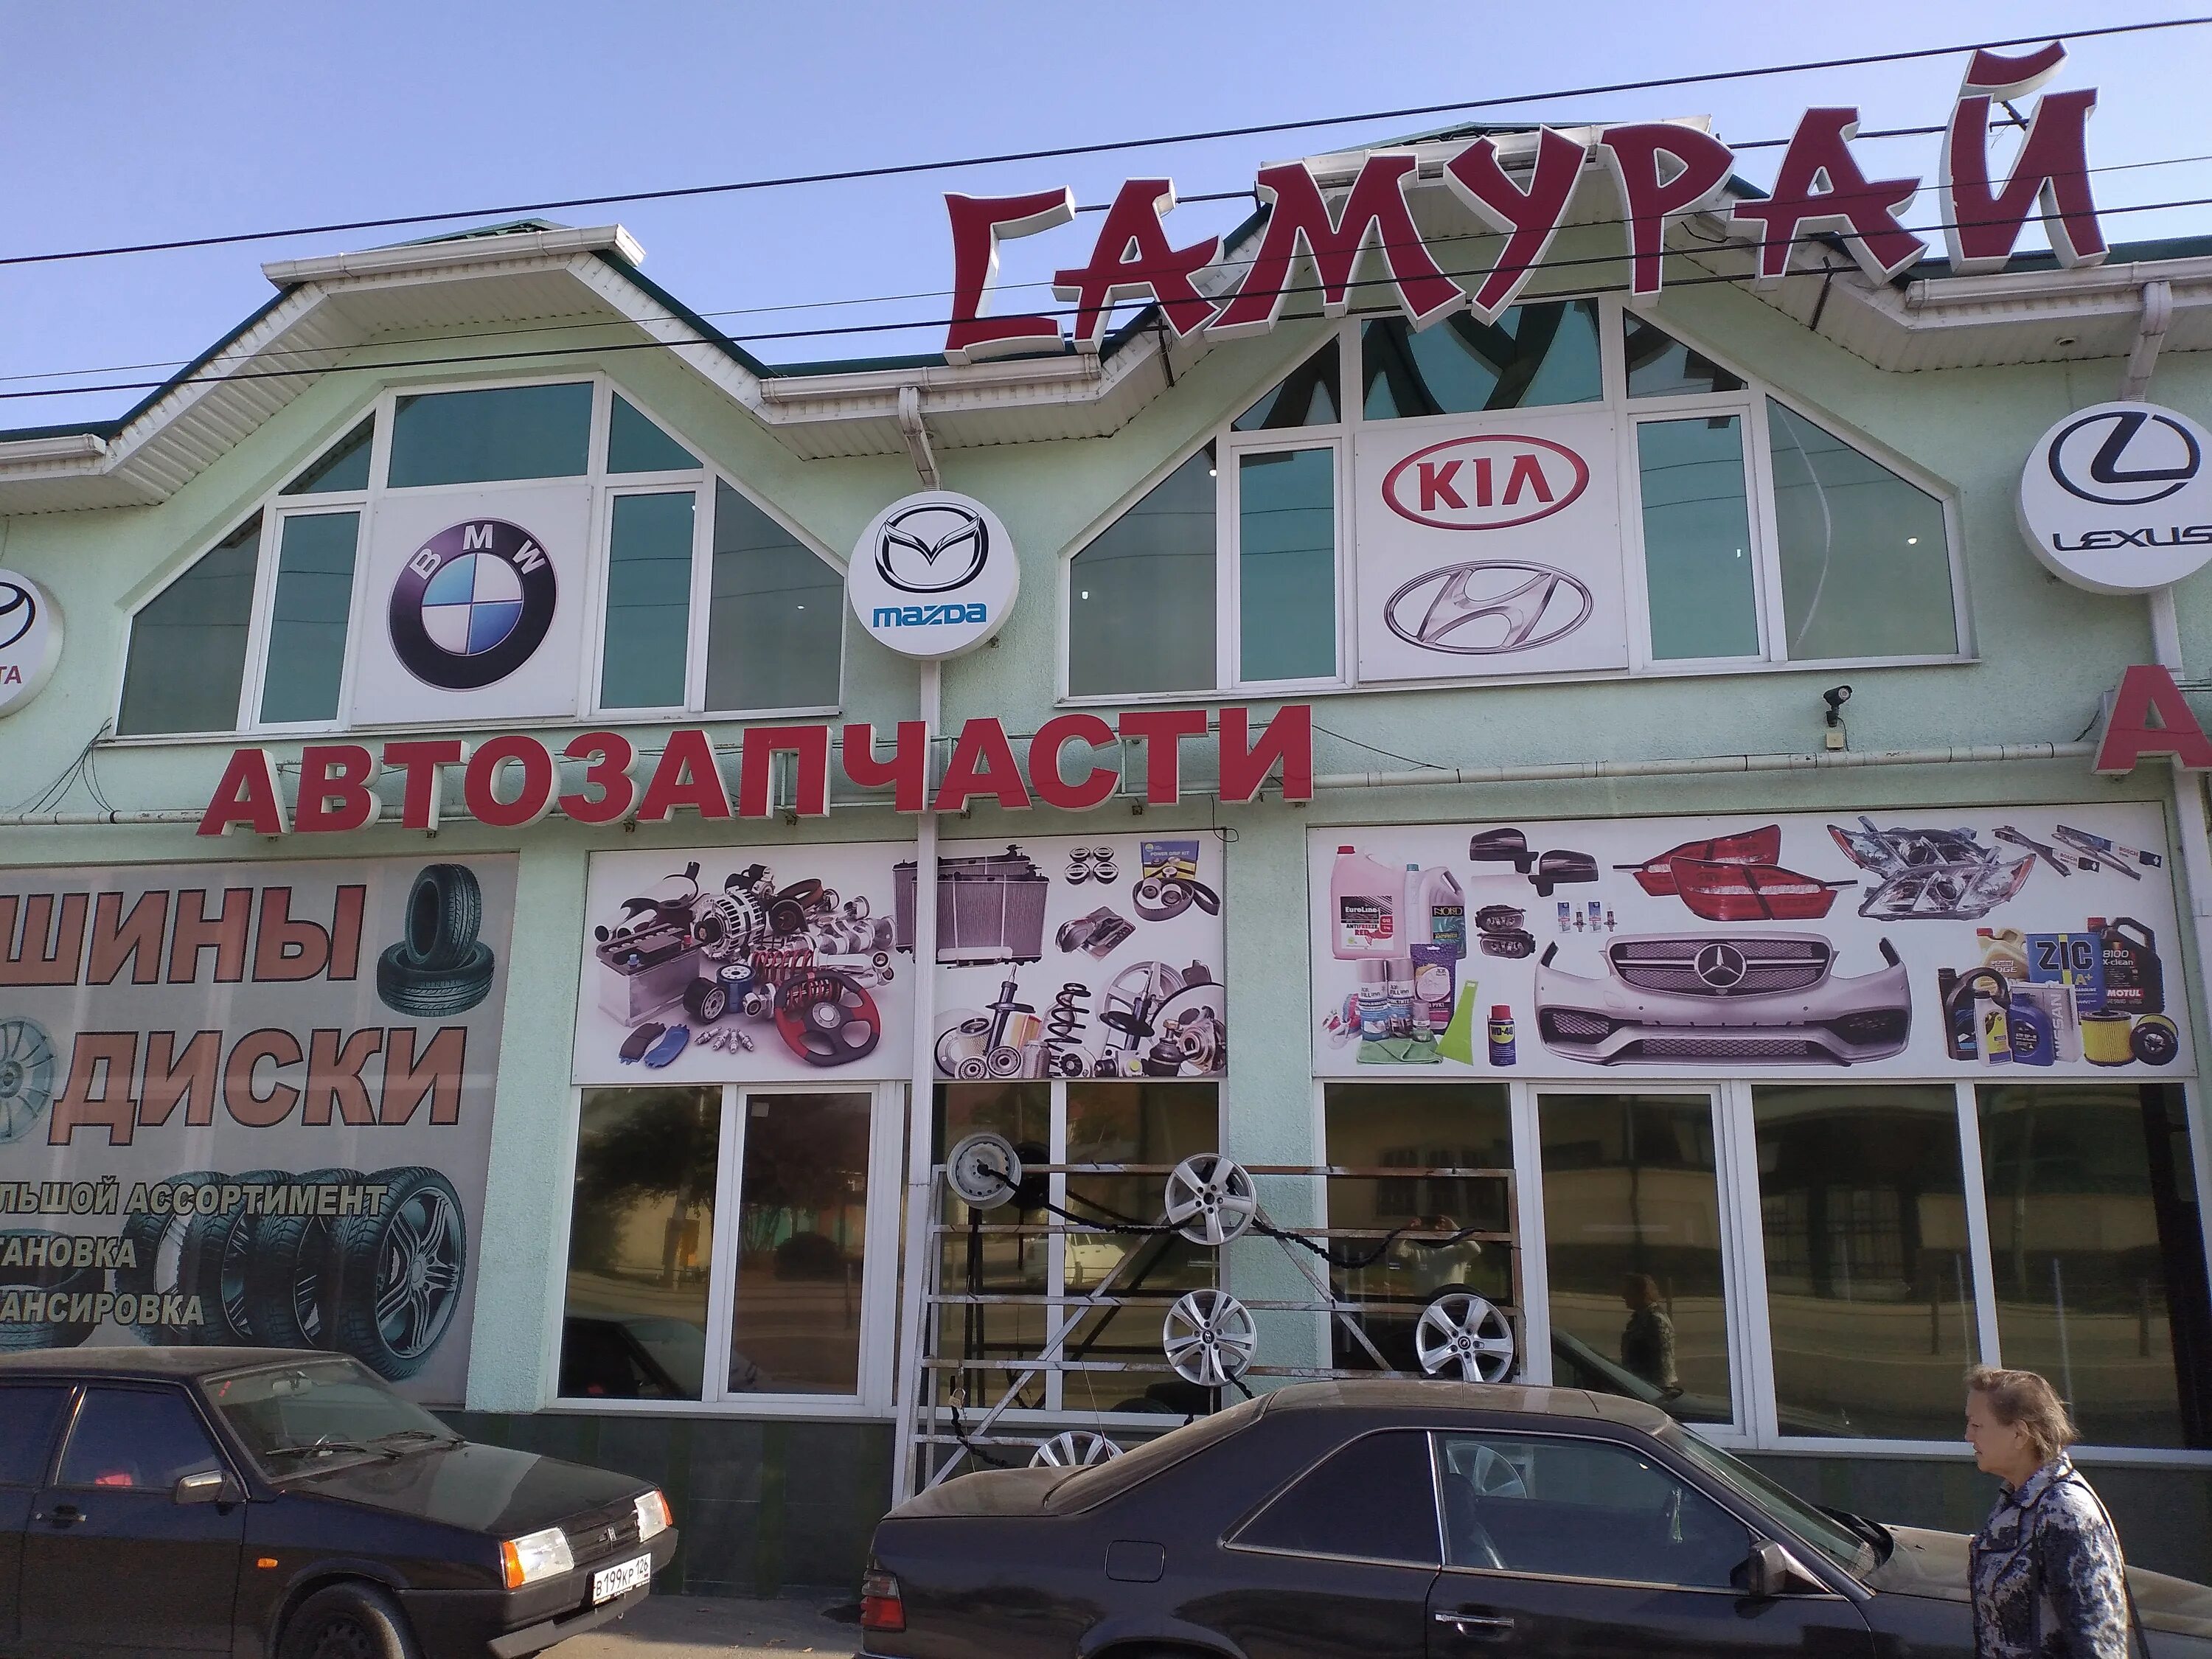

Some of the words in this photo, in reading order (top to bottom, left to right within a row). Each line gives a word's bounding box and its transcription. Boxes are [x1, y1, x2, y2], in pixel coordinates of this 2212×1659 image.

[942, 40, 2111, 366] САМУРАЙ
[1416, 453, 1555, 512] KIA
[408, 524, 546, 580] BMW
[2052, 524, 2212, 552] LEXUS
[195, 704, 1315, 838] АВТОЗАПЧАСТИ
[1433, 907, 1463, 916] NORD
[0, 884, 368, 987] ШИНЫ
[2035, 940, 2095, 971] ZIC
[2103, 950, 2129, 959] 8100
[2107, 989, 2142, 997] MOTUL
[1490, 1026, 1514, 1036] WD-40
[46, 1026, 468, 1147] ДИСКИ
[124, 1182, 389, 1217] АССОРТИМЕНТ
